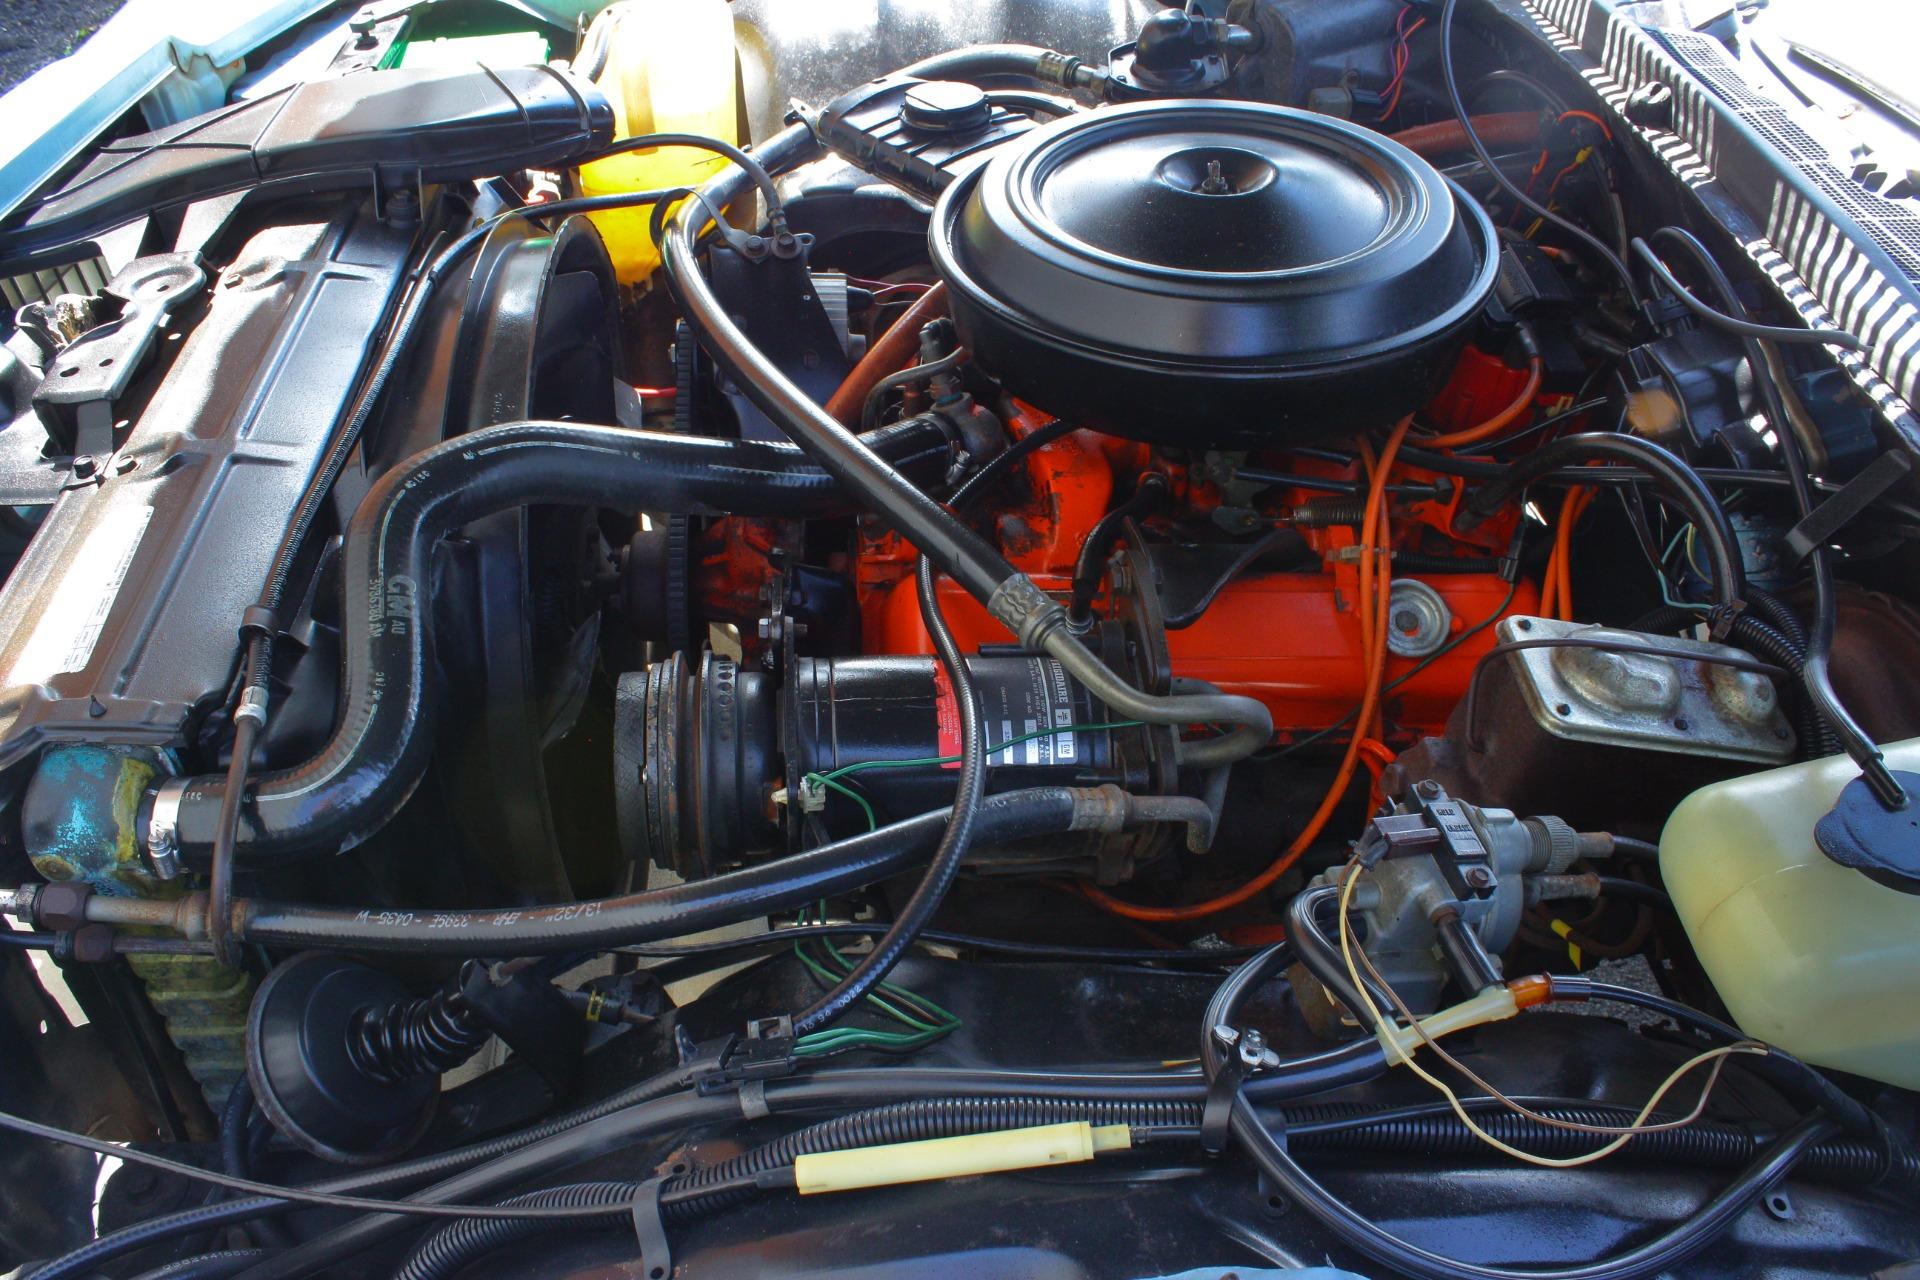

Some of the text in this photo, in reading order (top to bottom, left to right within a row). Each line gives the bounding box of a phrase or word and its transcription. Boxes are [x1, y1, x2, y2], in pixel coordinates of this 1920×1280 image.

[386, 574, 417, 635] GM AU
[1063, 744, 1070, 754] GM
